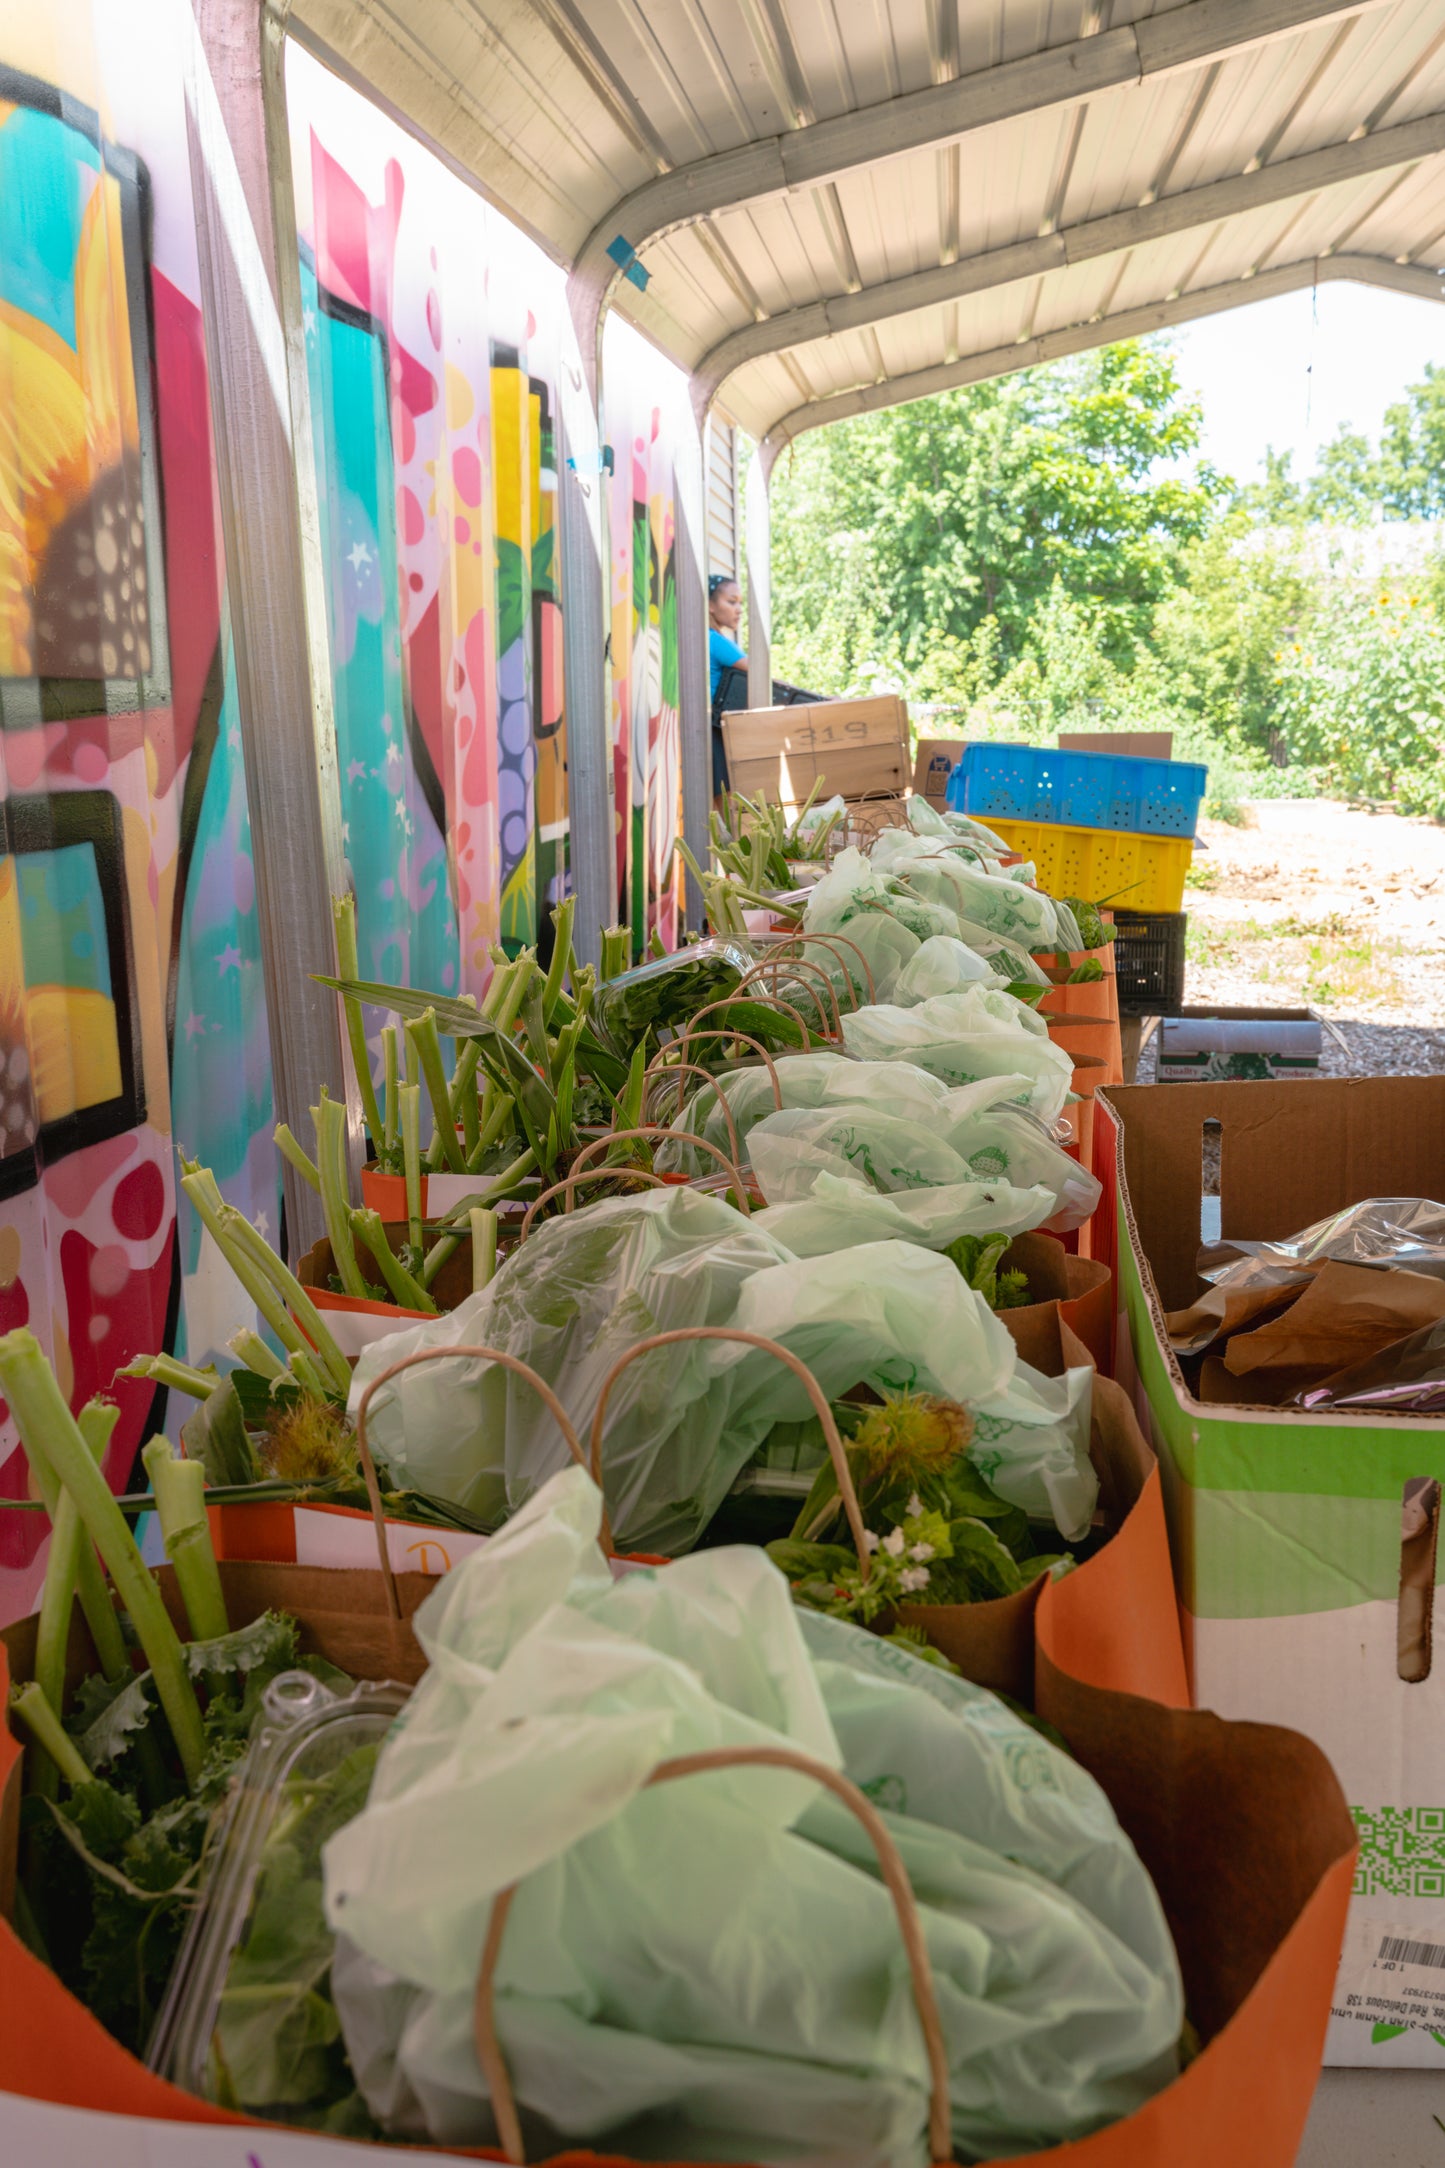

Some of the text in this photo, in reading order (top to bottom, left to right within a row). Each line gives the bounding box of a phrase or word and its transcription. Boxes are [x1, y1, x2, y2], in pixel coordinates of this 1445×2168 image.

[794, 721, 868, 745] 319
[1164, 1066, 1314, 1078] Quality Produce
[1381, 1962, 1396, 1971] OF
[1366, 1996, 1408, 2014] Delicious
[1408, 2003, 1429, 2017] Red
